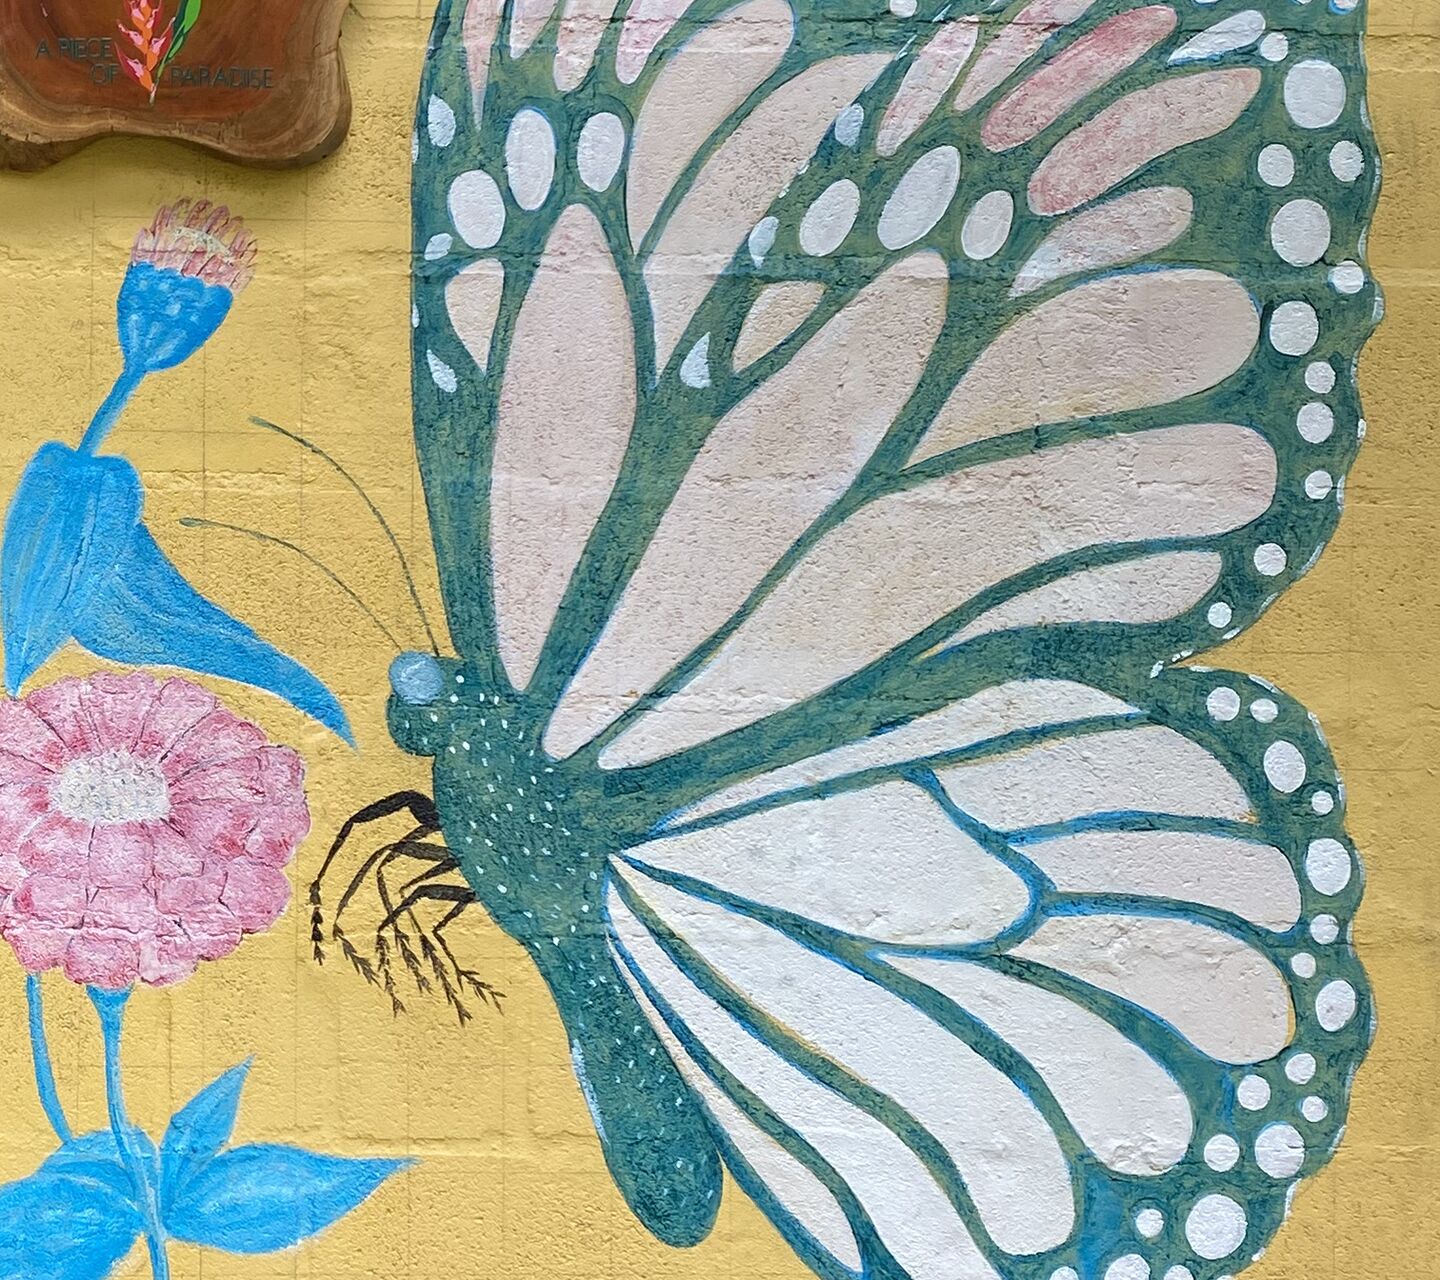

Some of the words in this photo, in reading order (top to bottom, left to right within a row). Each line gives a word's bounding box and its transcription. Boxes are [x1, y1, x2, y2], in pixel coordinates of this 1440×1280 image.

[35, 38, 50, 60] A
[58, 37, 113, 60] PIECE
[90, 63, 118, 86] OF
[170, 67, 274, 88] PARADISE
